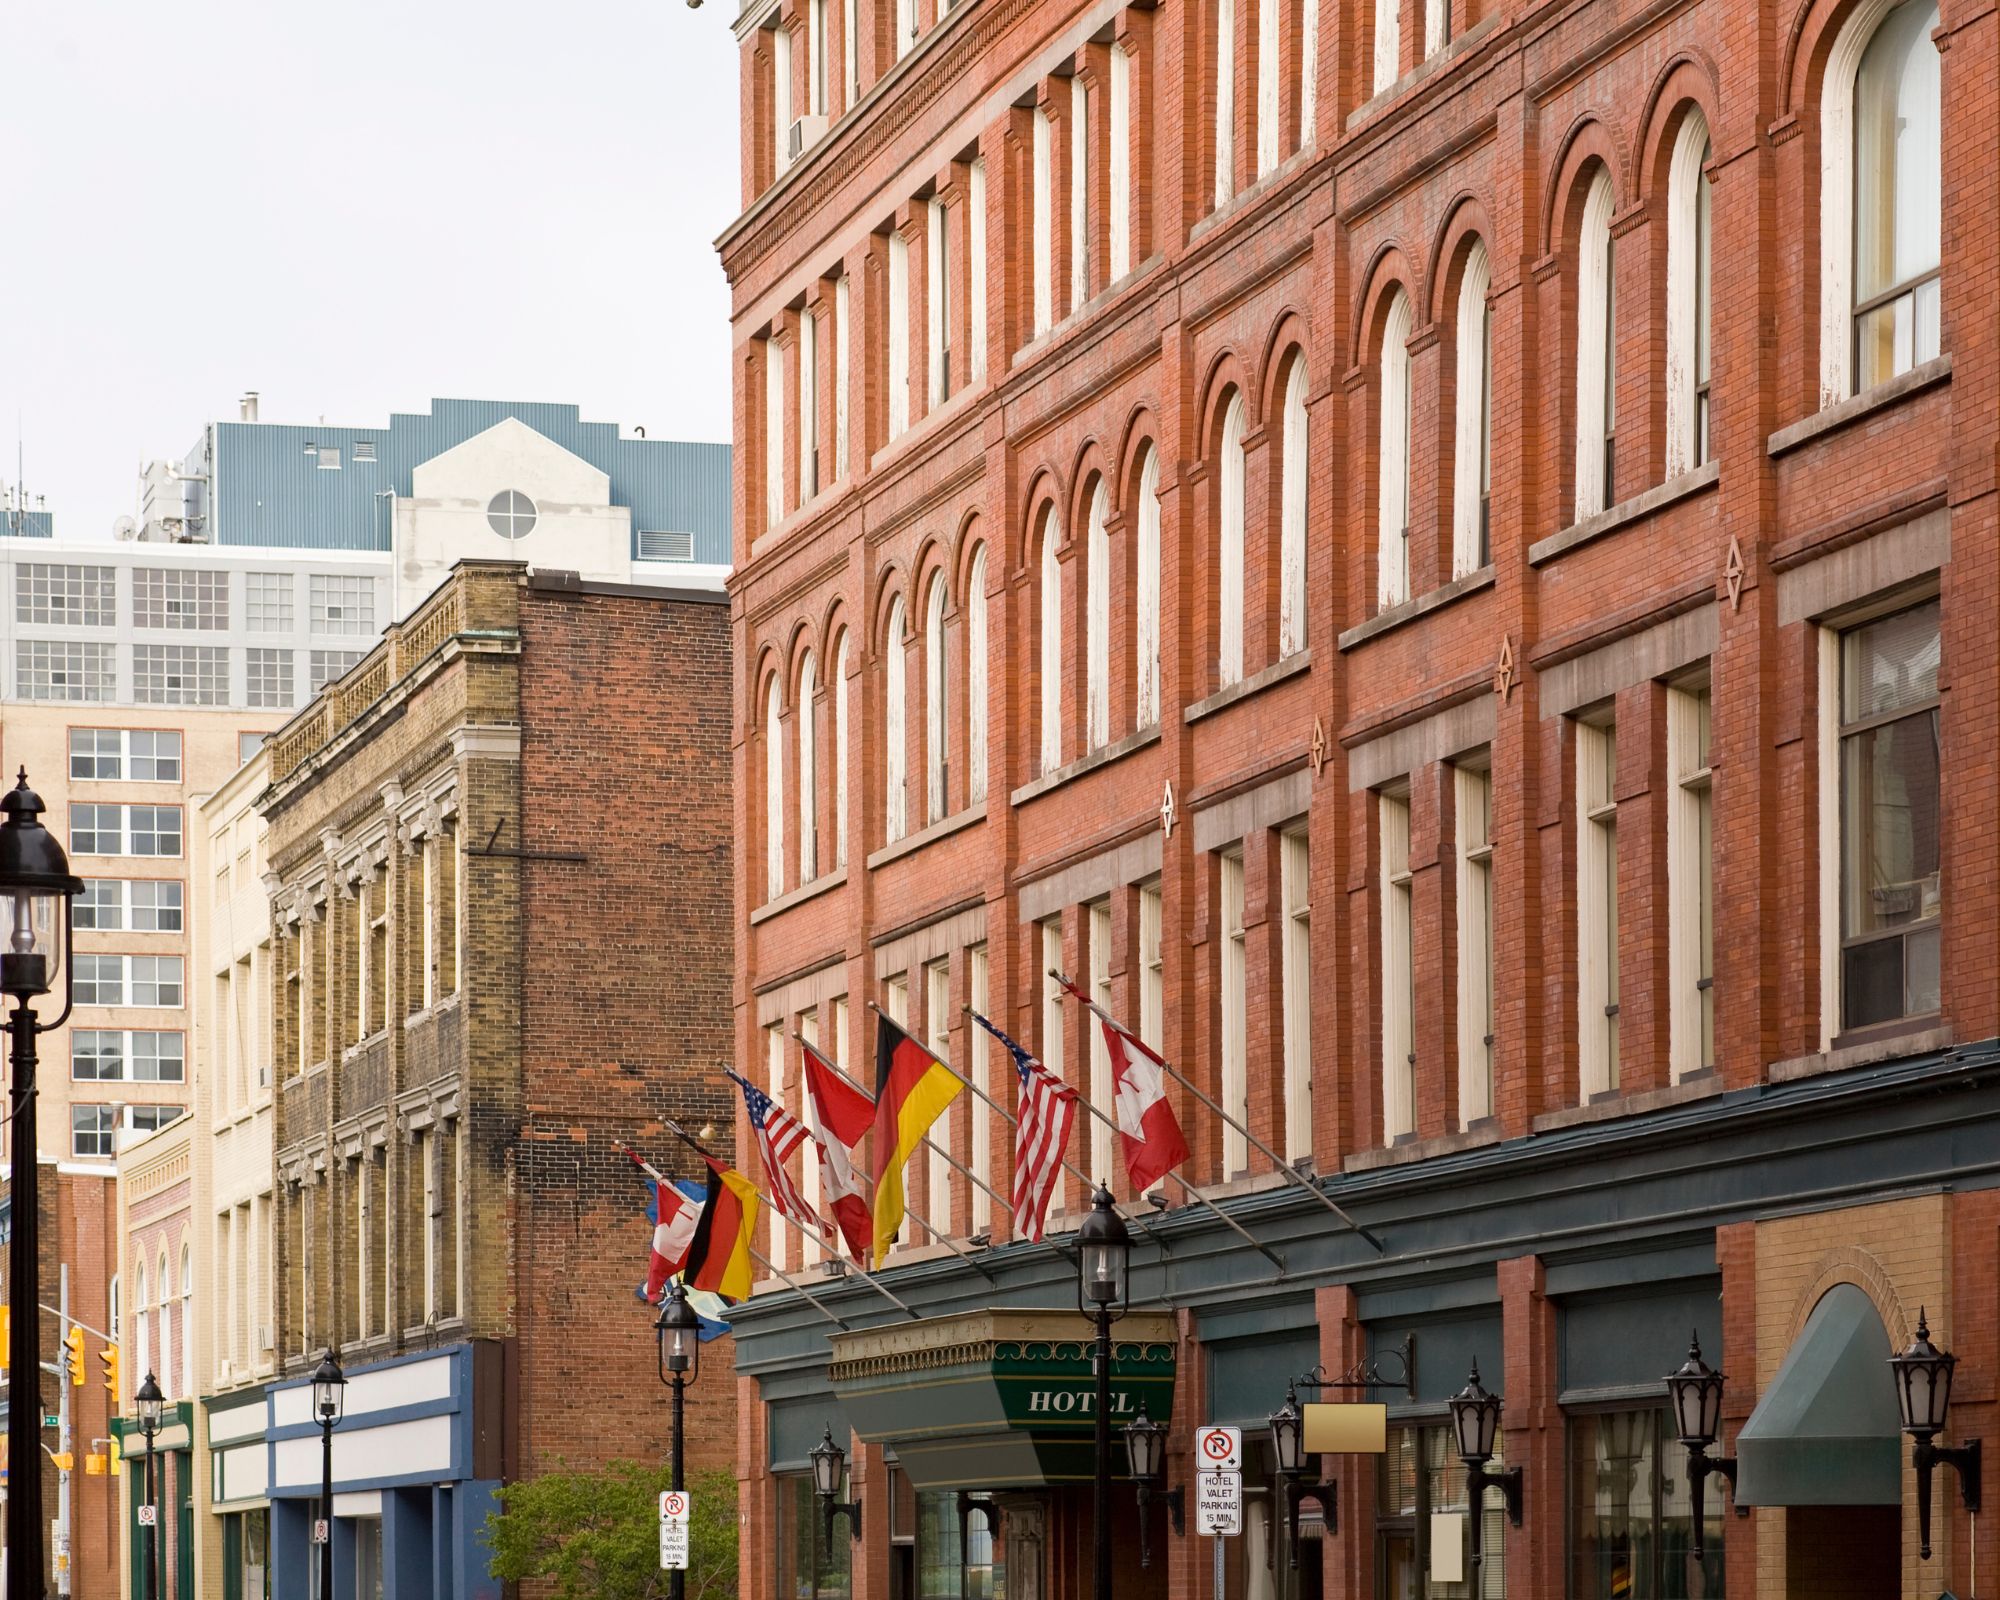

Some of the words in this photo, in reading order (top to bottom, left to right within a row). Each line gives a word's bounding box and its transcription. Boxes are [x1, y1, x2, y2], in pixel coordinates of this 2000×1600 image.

[1206, 1476, 1234, 1486] HOTEL
[1207, 1489, 1233, 1498] VALET
[1201, 1501, 1238, 1510] PARKING
[1206, 1513, 1214, 1522] 15
